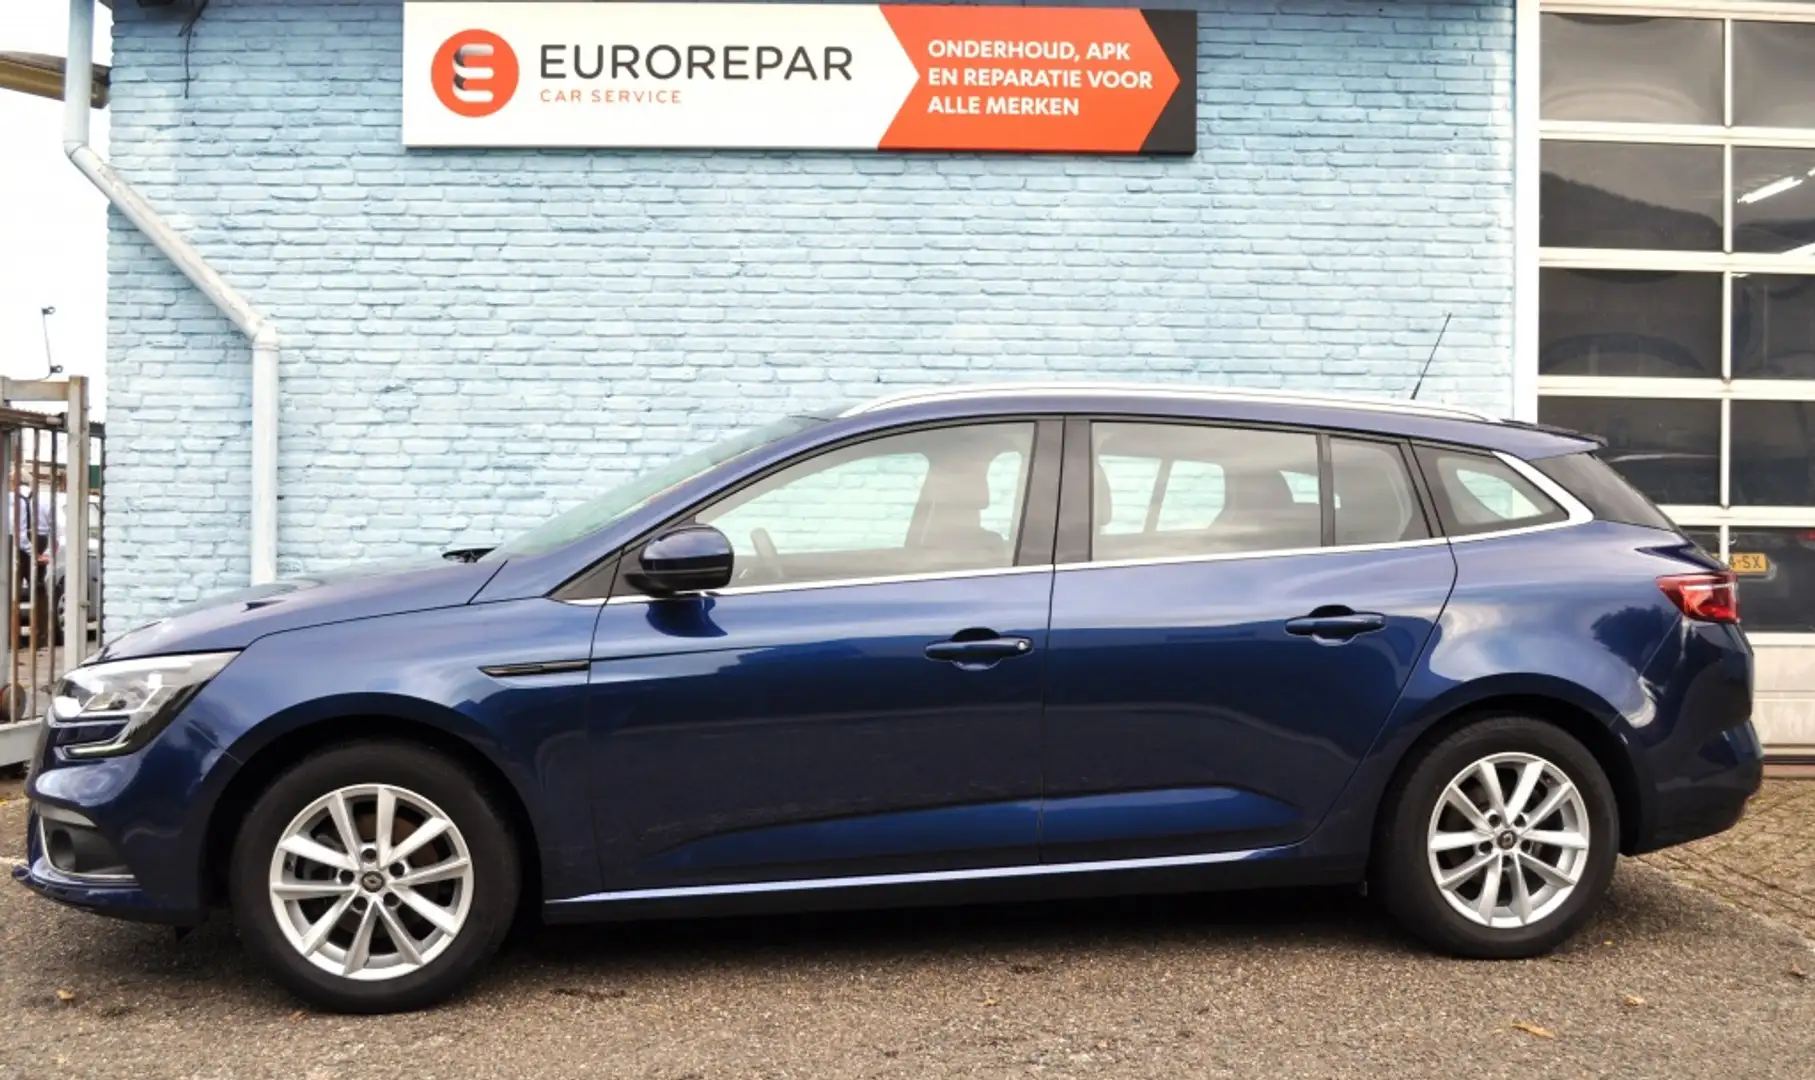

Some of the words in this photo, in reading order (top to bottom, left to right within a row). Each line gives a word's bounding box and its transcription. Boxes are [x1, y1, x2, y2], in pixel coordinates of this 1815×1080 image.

[927, 39, 1080, 62] ONDERHOUD,
[1086, 42, 1131, 61] APK
[539, 44, 854, 81] EUROREPAR
[928, 67, 958, 86] EN
[963, 68, 1082, 88] REPARATIE
[1086, 70, 1153, 89] VOOR
[540, 89, 582, 103] CAR
[591, 89, 682, 104] SERVICE
[927, 96, 981, 114] ALLE
[985, 97, 1079, 116] MERKEN
